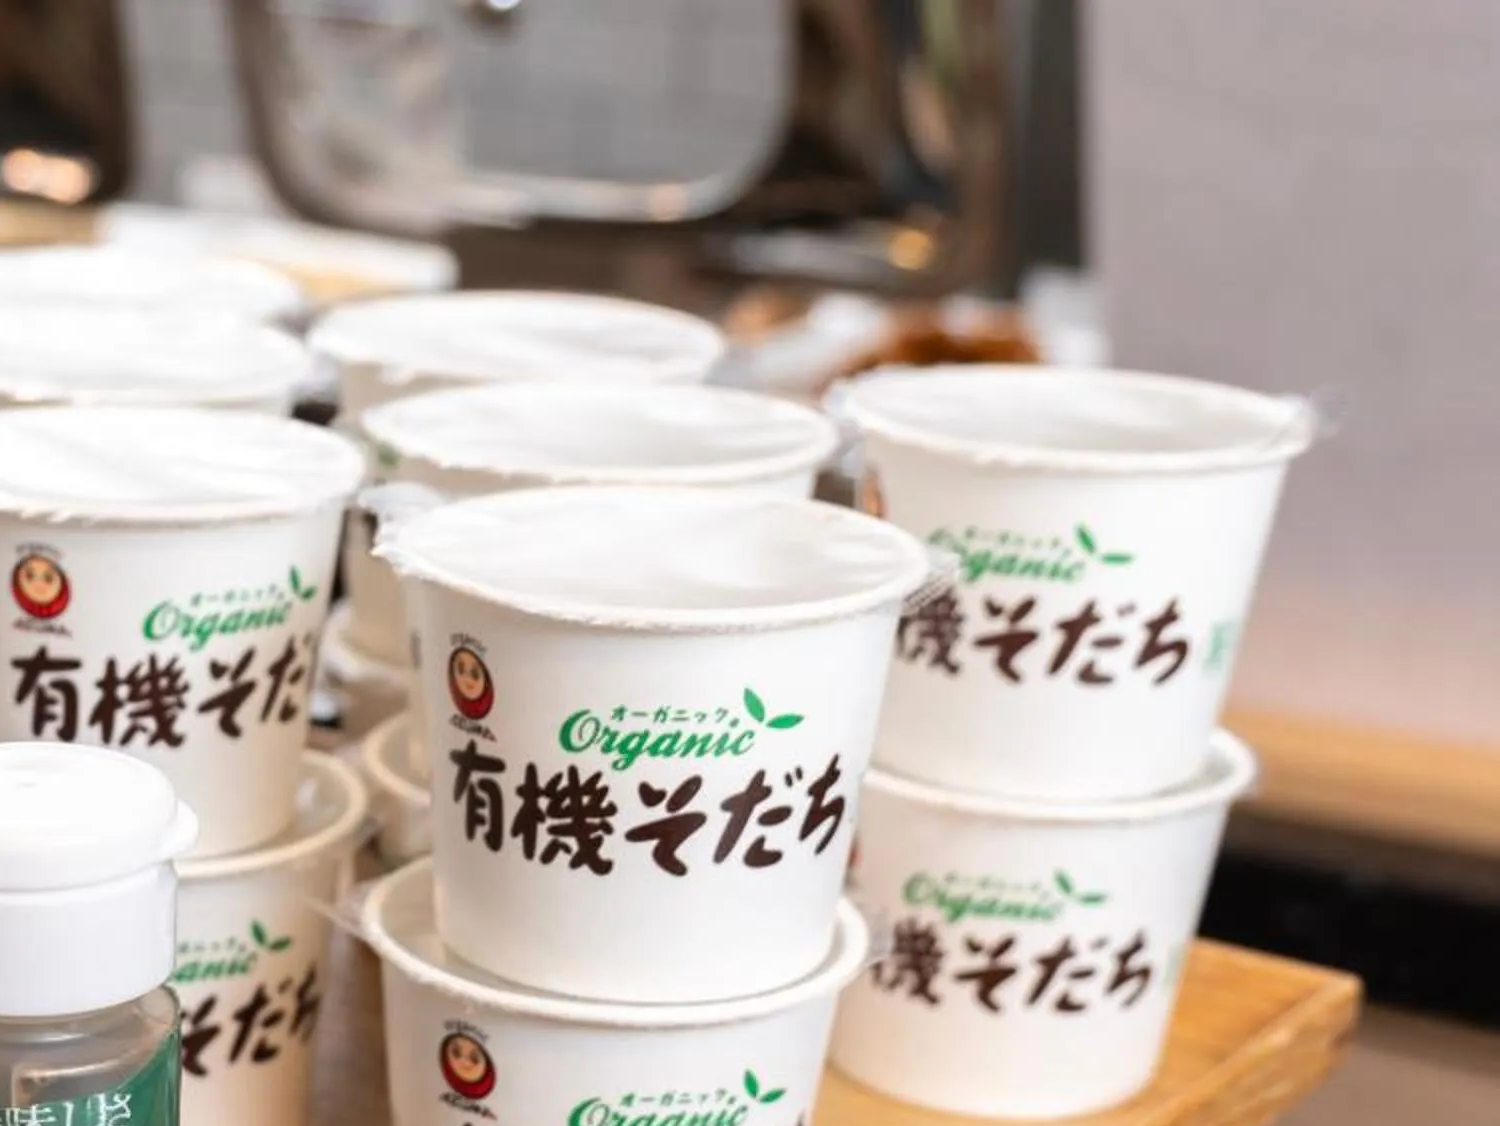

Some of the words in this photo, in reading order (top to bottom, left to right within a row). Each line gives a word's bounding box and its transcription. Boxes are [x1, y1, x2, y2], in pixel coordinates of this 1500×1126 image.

[143, 599, 293, 652] Organic
[558, 709, 757, 771] Organic
[611, 704, 730, 724] オーガニック
[449, 739, 846, 877] 有機そだち
